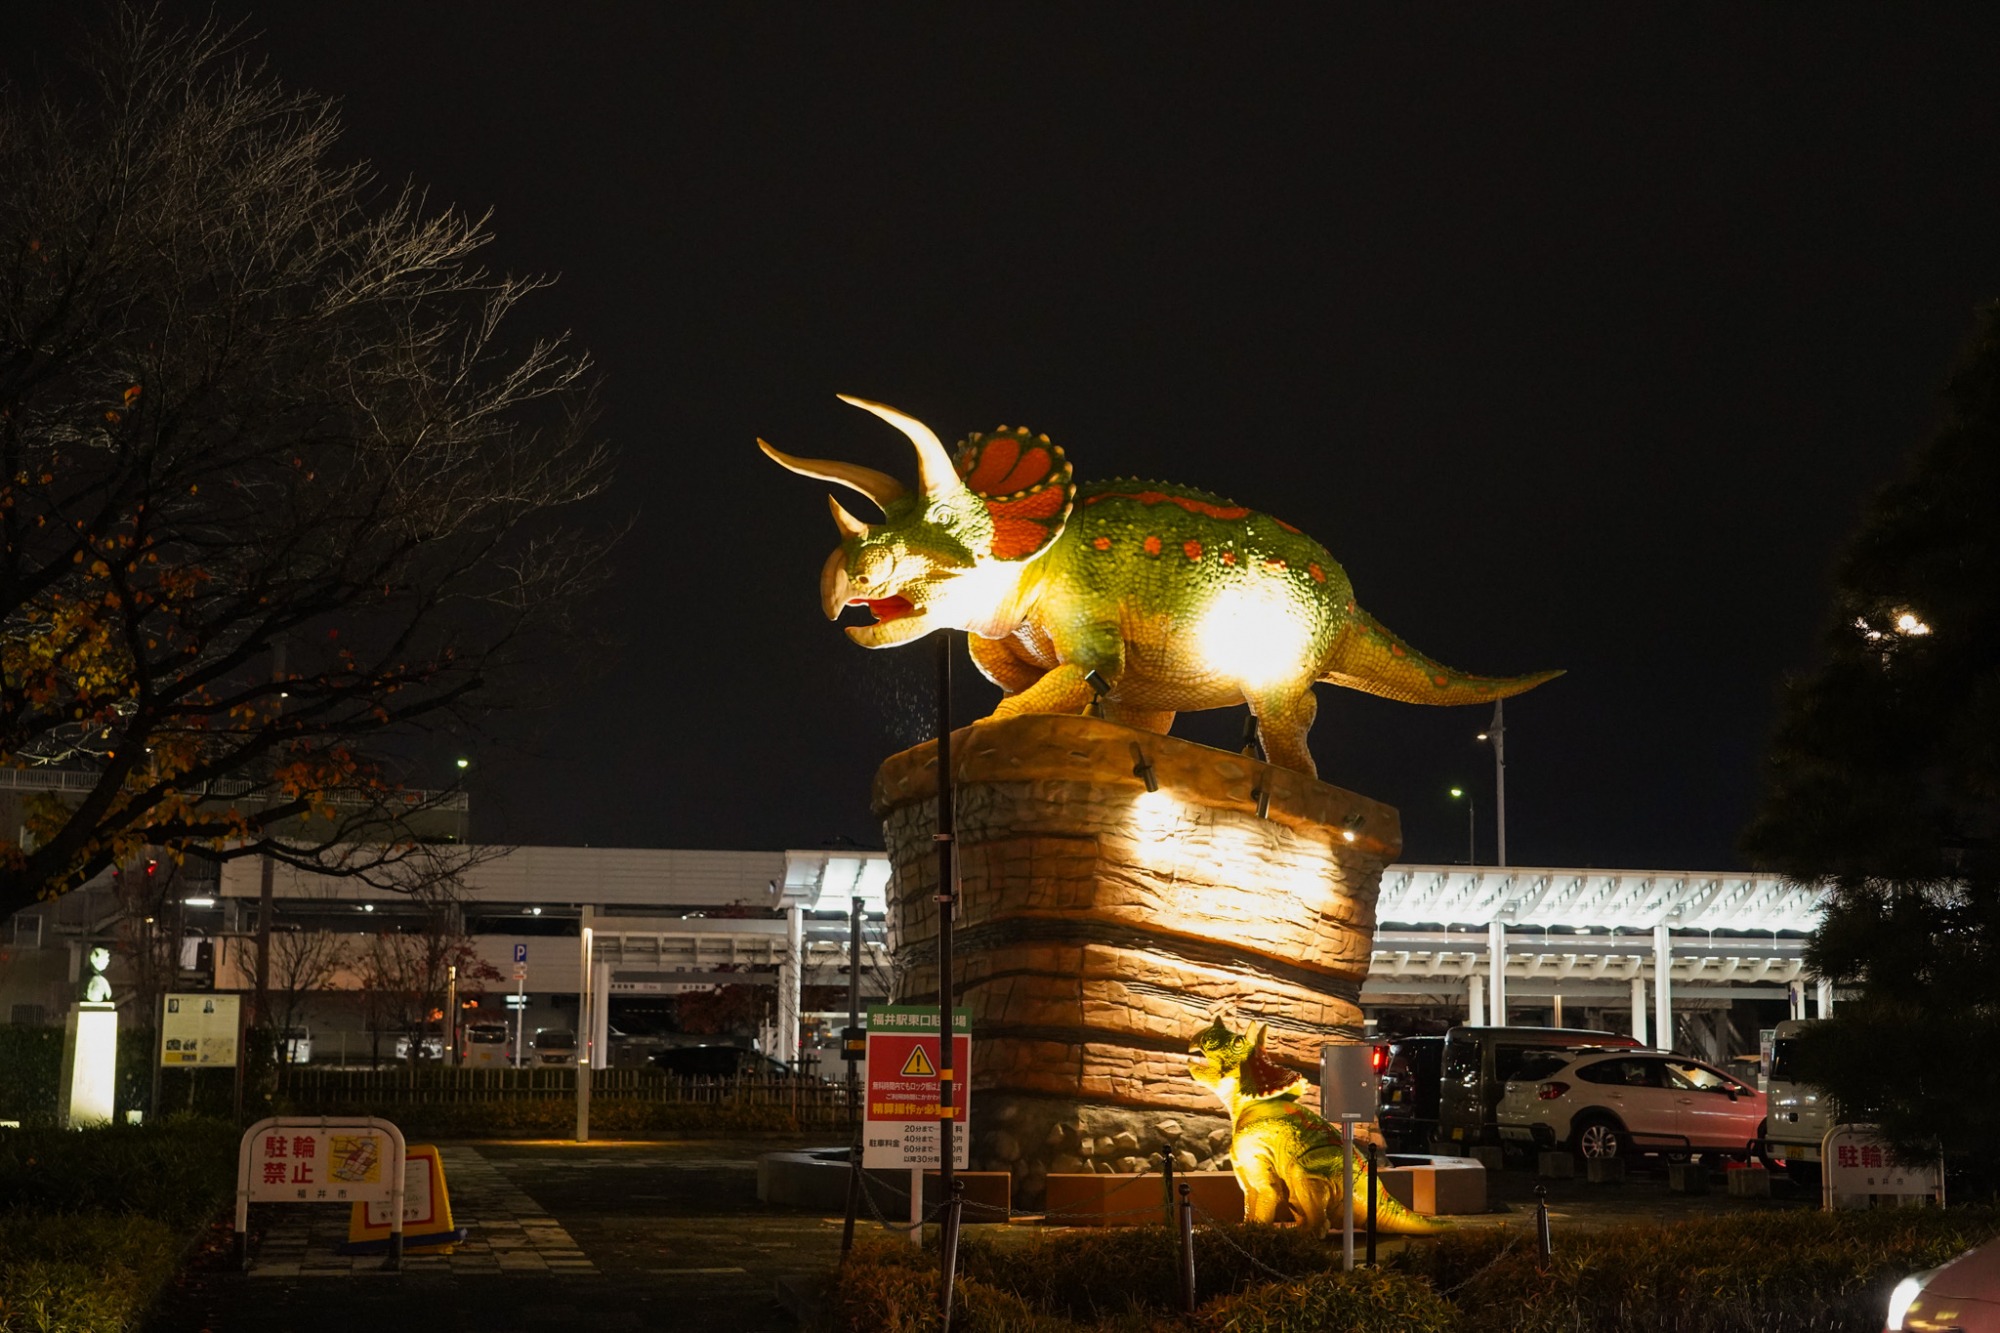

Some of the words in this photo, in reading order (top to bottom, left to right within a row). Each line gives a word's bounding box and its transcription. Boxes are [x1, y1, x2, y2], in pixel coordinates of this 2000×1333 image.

[872, 1013, 967, 1027] 福井駅東口駐場
[264, 1135, 316, 1158] 駐輪
[263, 1161, 314, 1184] 禁止
